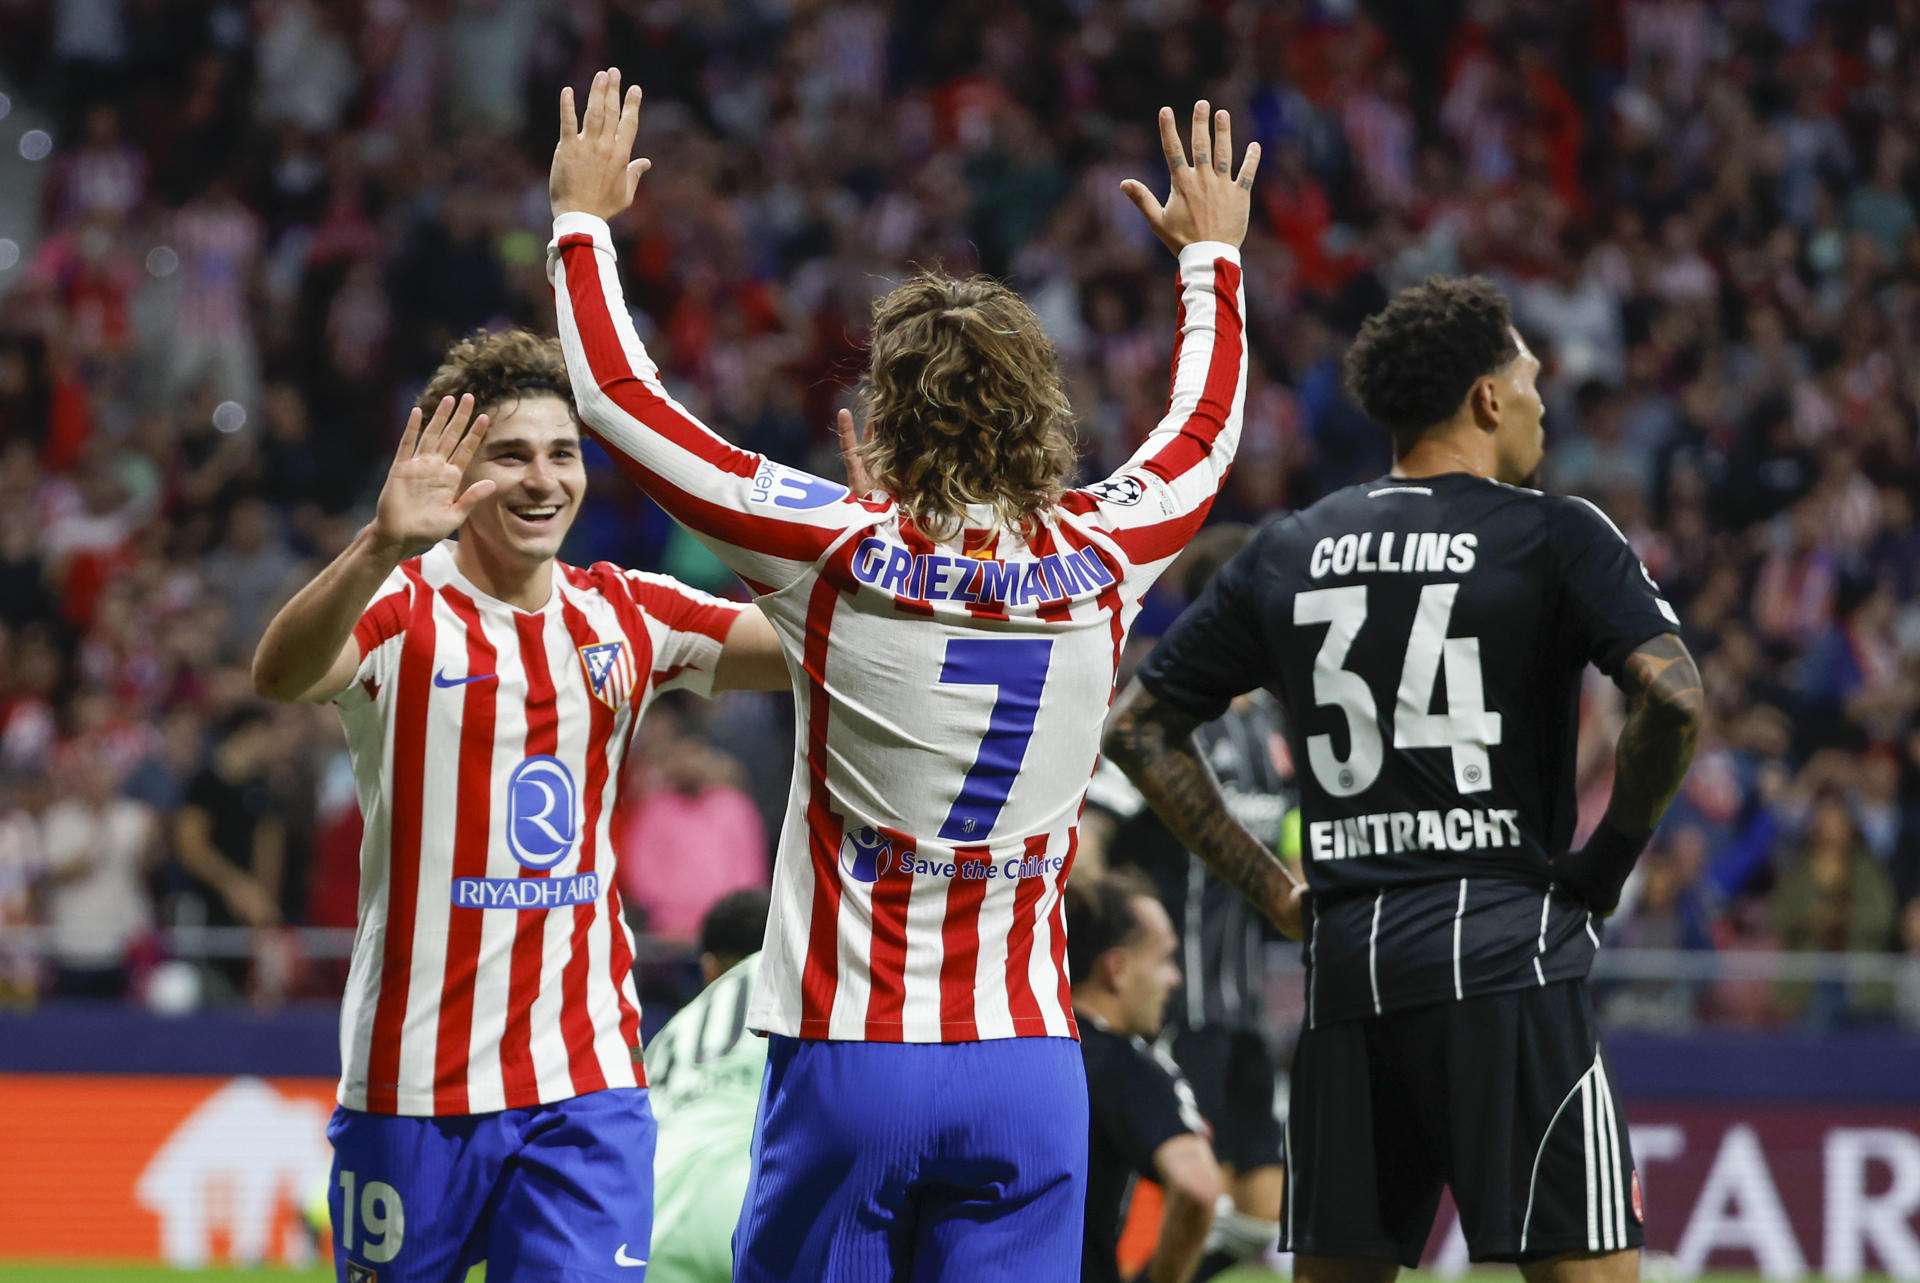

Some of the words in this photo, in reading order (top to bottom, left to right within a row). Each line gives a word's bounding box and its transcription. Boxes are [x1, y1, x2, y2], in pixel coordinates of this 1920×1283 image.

[851, 536, 1117, 605] GRIEZMANN
[1310, 532, 1478, 578] COLLINS
[1293, 583, 1502, 797] 34
[938, 637, 1055, 842] 7
[1309, 808, 1521, 861] EINTRACHT
[459, 880, 562, 906] RIYADH
[564, 875, 597, 902] AIR
[900, 851, 956, 878] Save
[962, 860, 998, 879] the
[1004, 854, 1063, 880] Childre
[340, 1170, 404, 1263] 19
